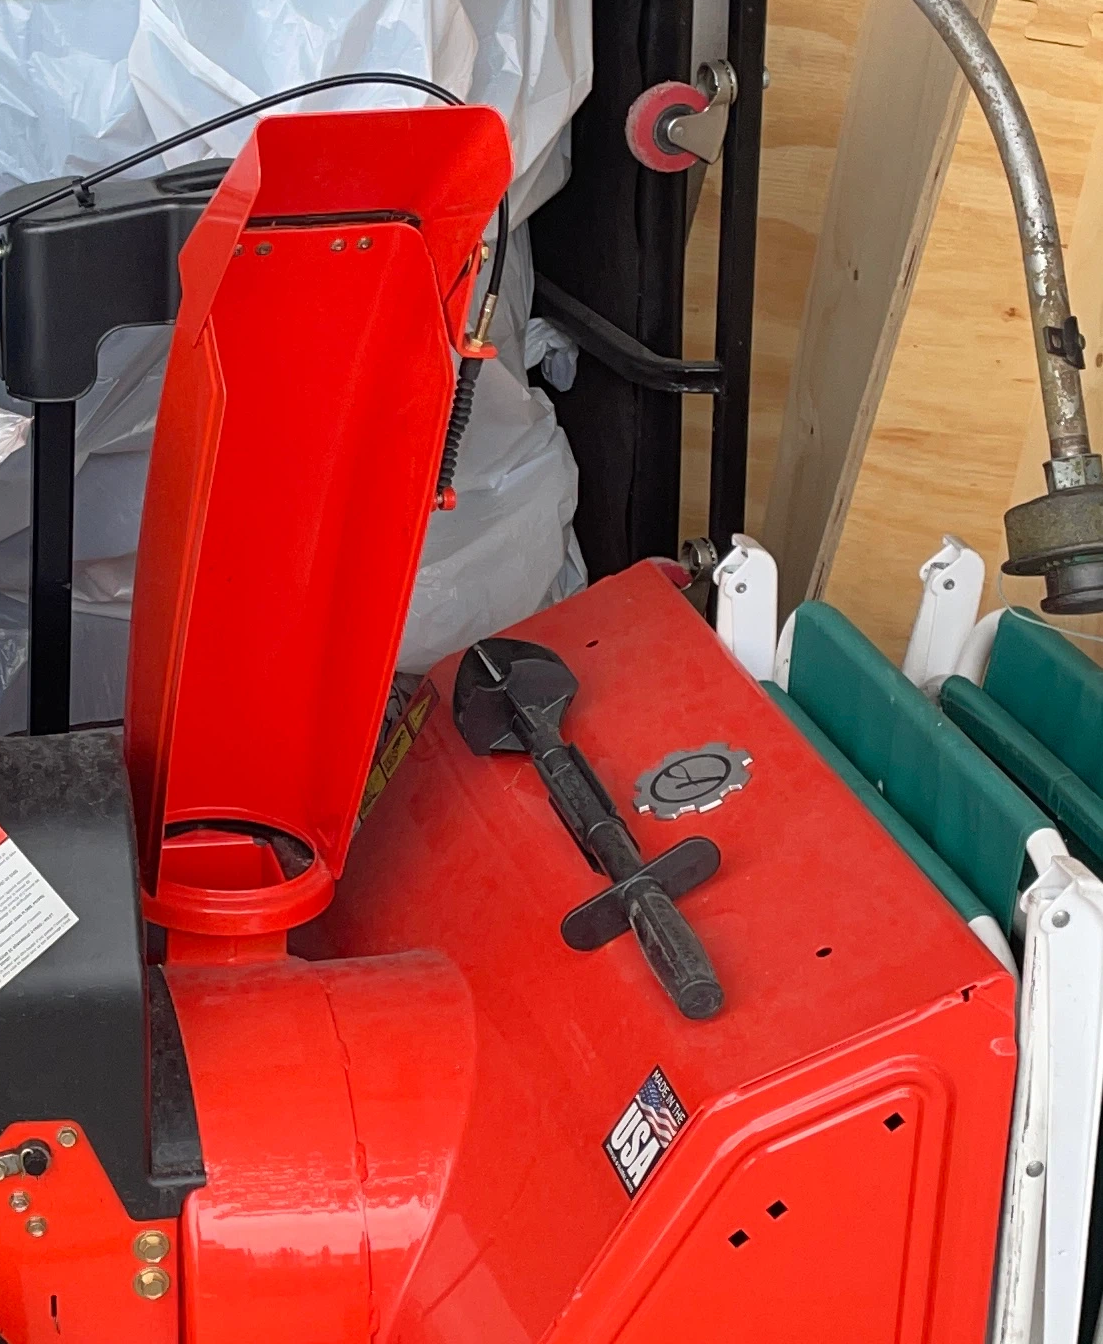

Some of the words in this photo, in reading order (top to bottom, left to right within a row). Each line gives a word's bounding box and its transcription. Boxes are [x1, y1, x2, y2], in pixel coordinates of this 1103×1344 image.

[652, 1069, 671, 1098] MADE
[665, 1094, 675, 1108] IN
[672, 1102, 686, 1125] THE
[611, 1102, 661, 1188] USA
